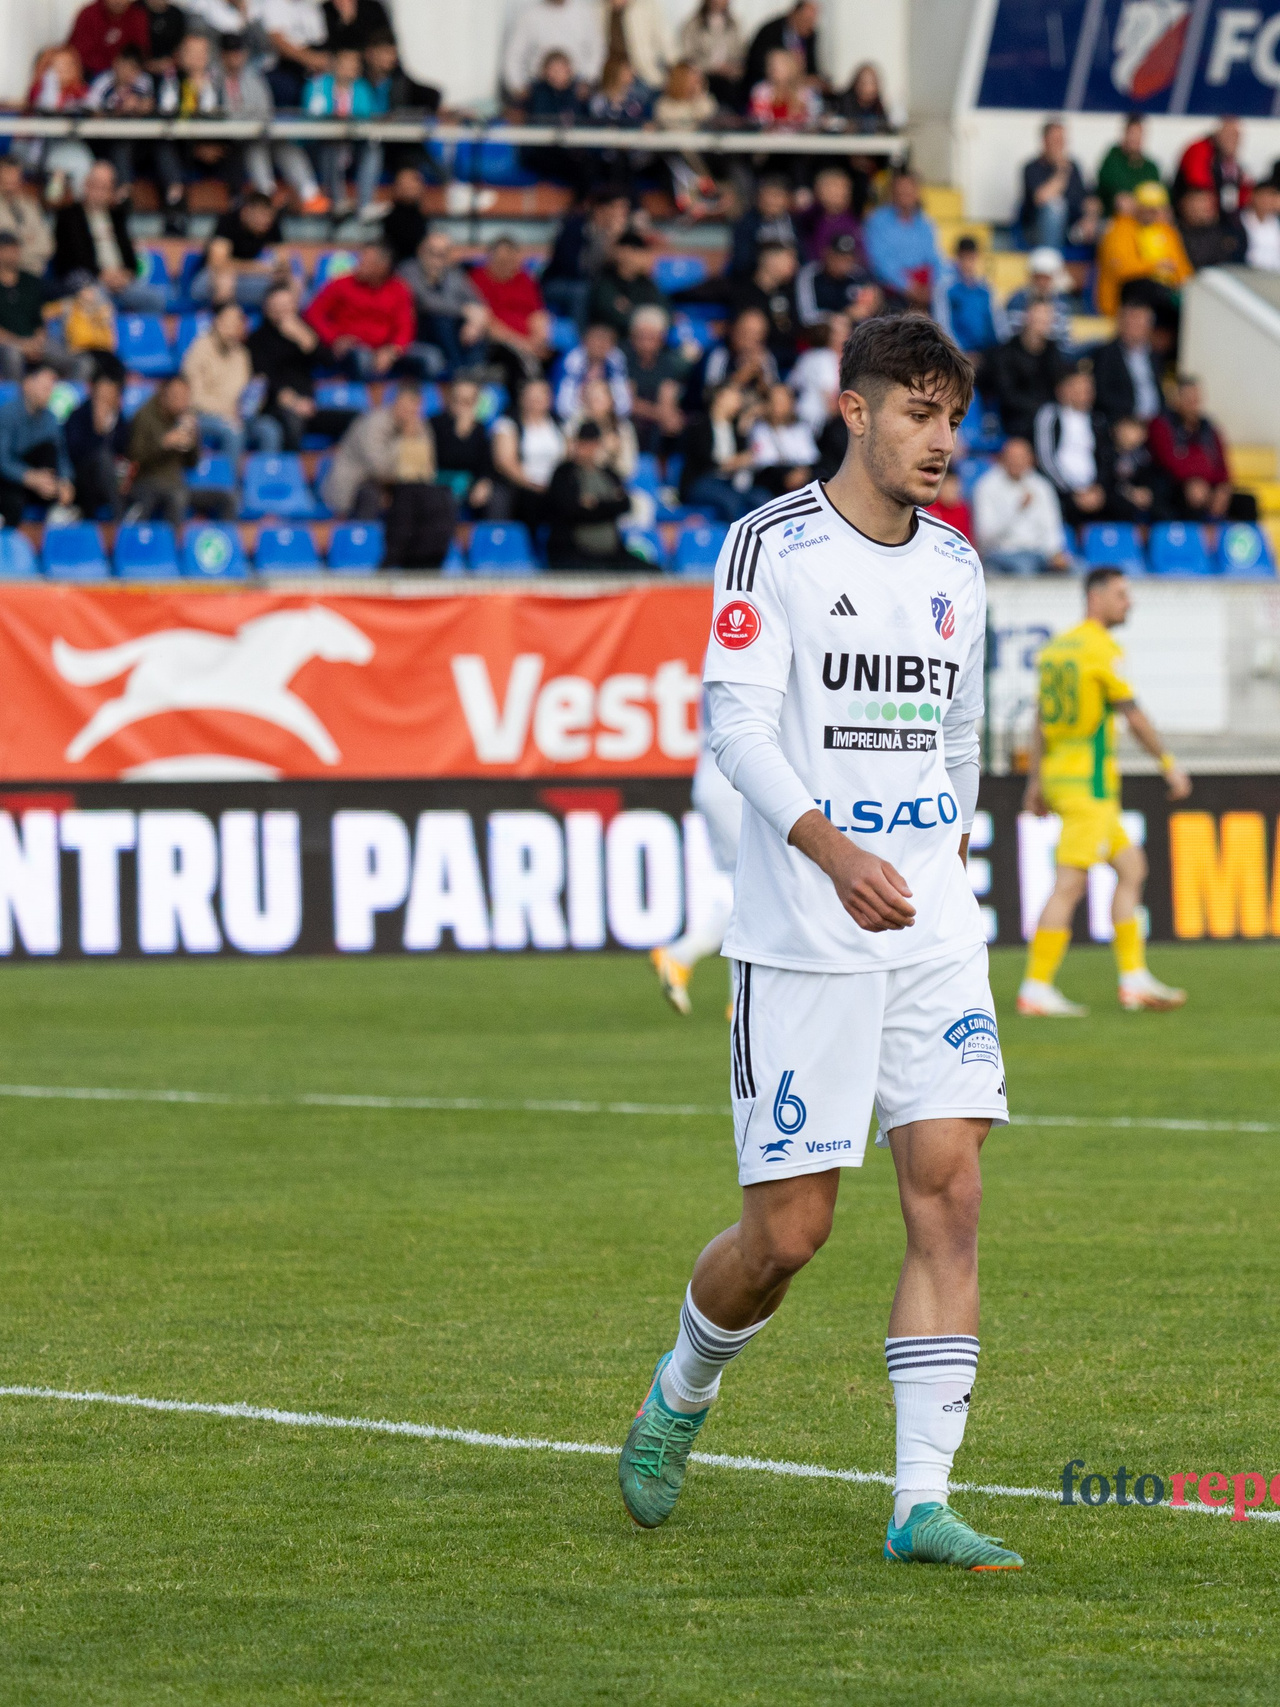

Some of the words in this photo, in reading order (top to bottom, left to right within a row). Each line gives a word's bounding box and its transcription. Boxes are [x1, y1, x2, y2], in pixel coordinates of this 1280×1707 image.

[778, 534, 831, 559] ELECTROALFA
[822, 652, 960, 700] UNIBET
[832, 727, 903, 749] ÎMPREUNĂ
[814, 792, 958, 834] LSACO
[948, 1023, 969, 1044] FIVE
[773, 1070, 807, 1135] 6
[805, 1139, 852, 1154] Vestra
